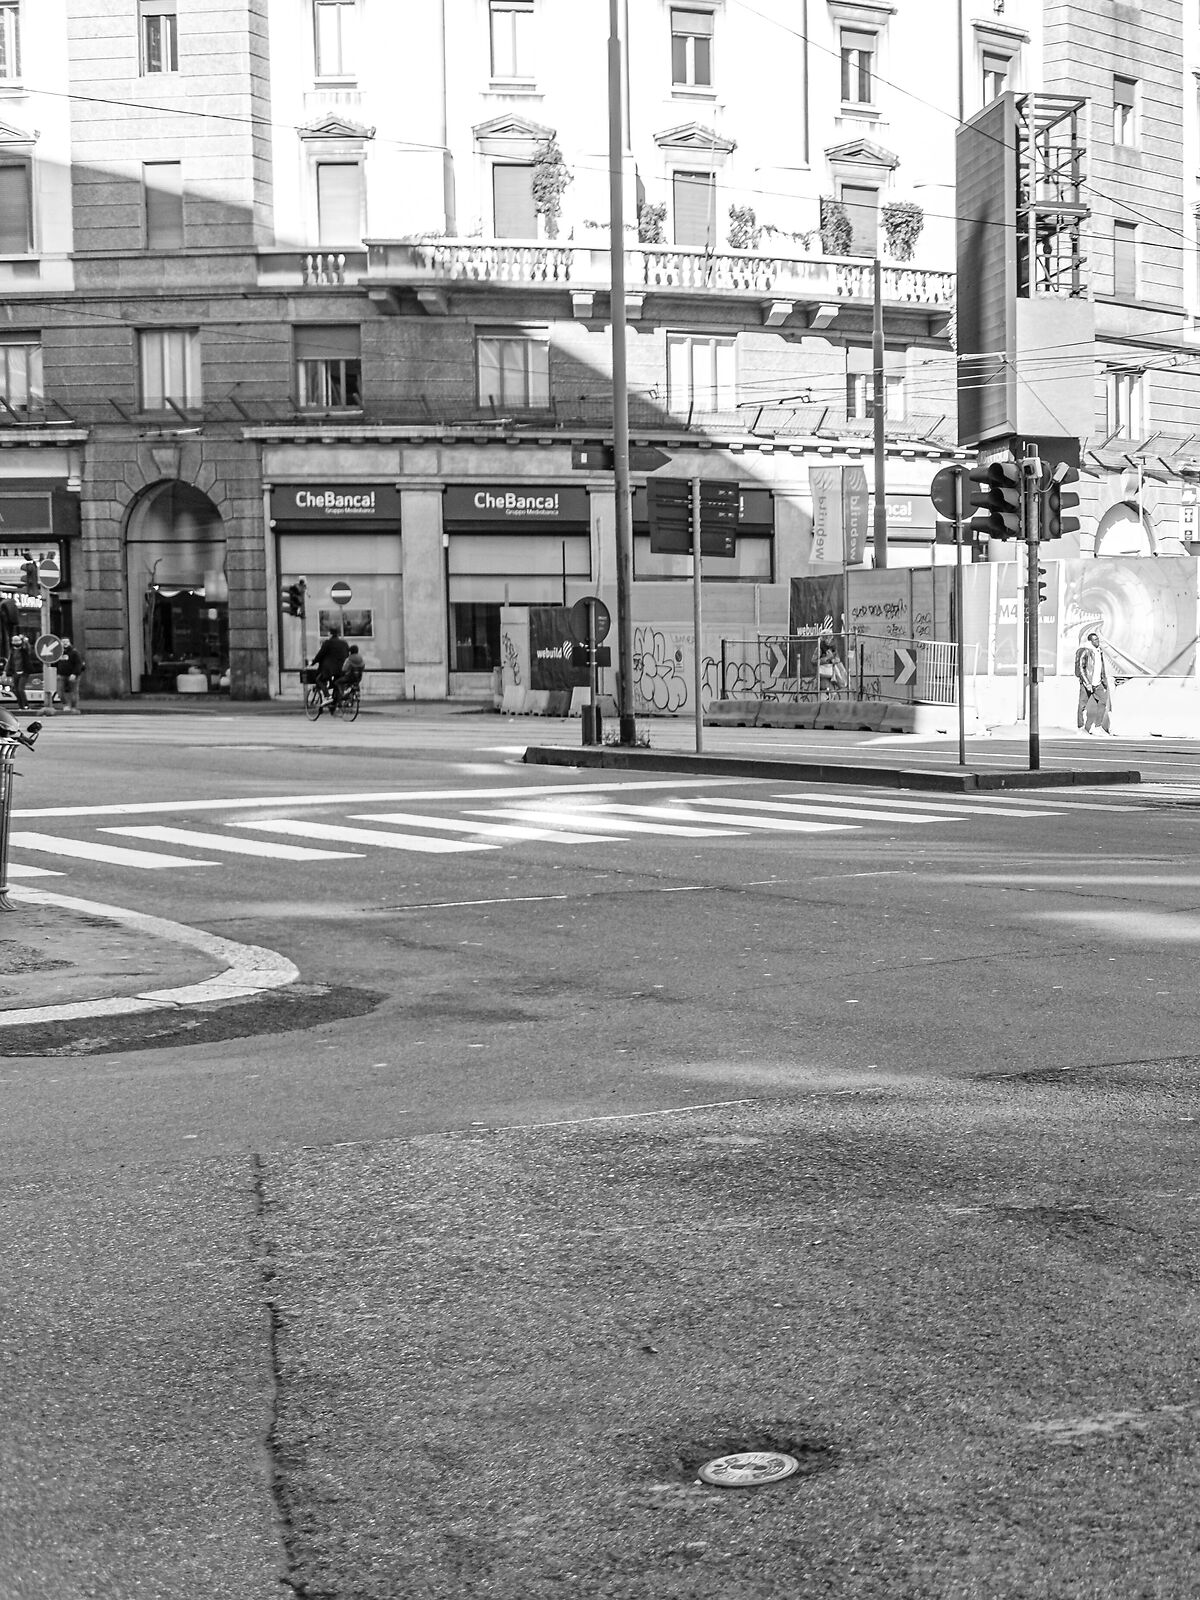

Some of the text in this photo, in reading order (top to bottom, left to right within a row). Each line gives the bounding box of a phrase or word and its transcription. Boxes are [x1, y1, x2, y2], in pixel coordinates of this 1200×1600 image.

[296, 491, 375, 507] CheBanca!
[474, 492, 559, 509] CheBanca!
[537, 646, 563, 659] webuild
